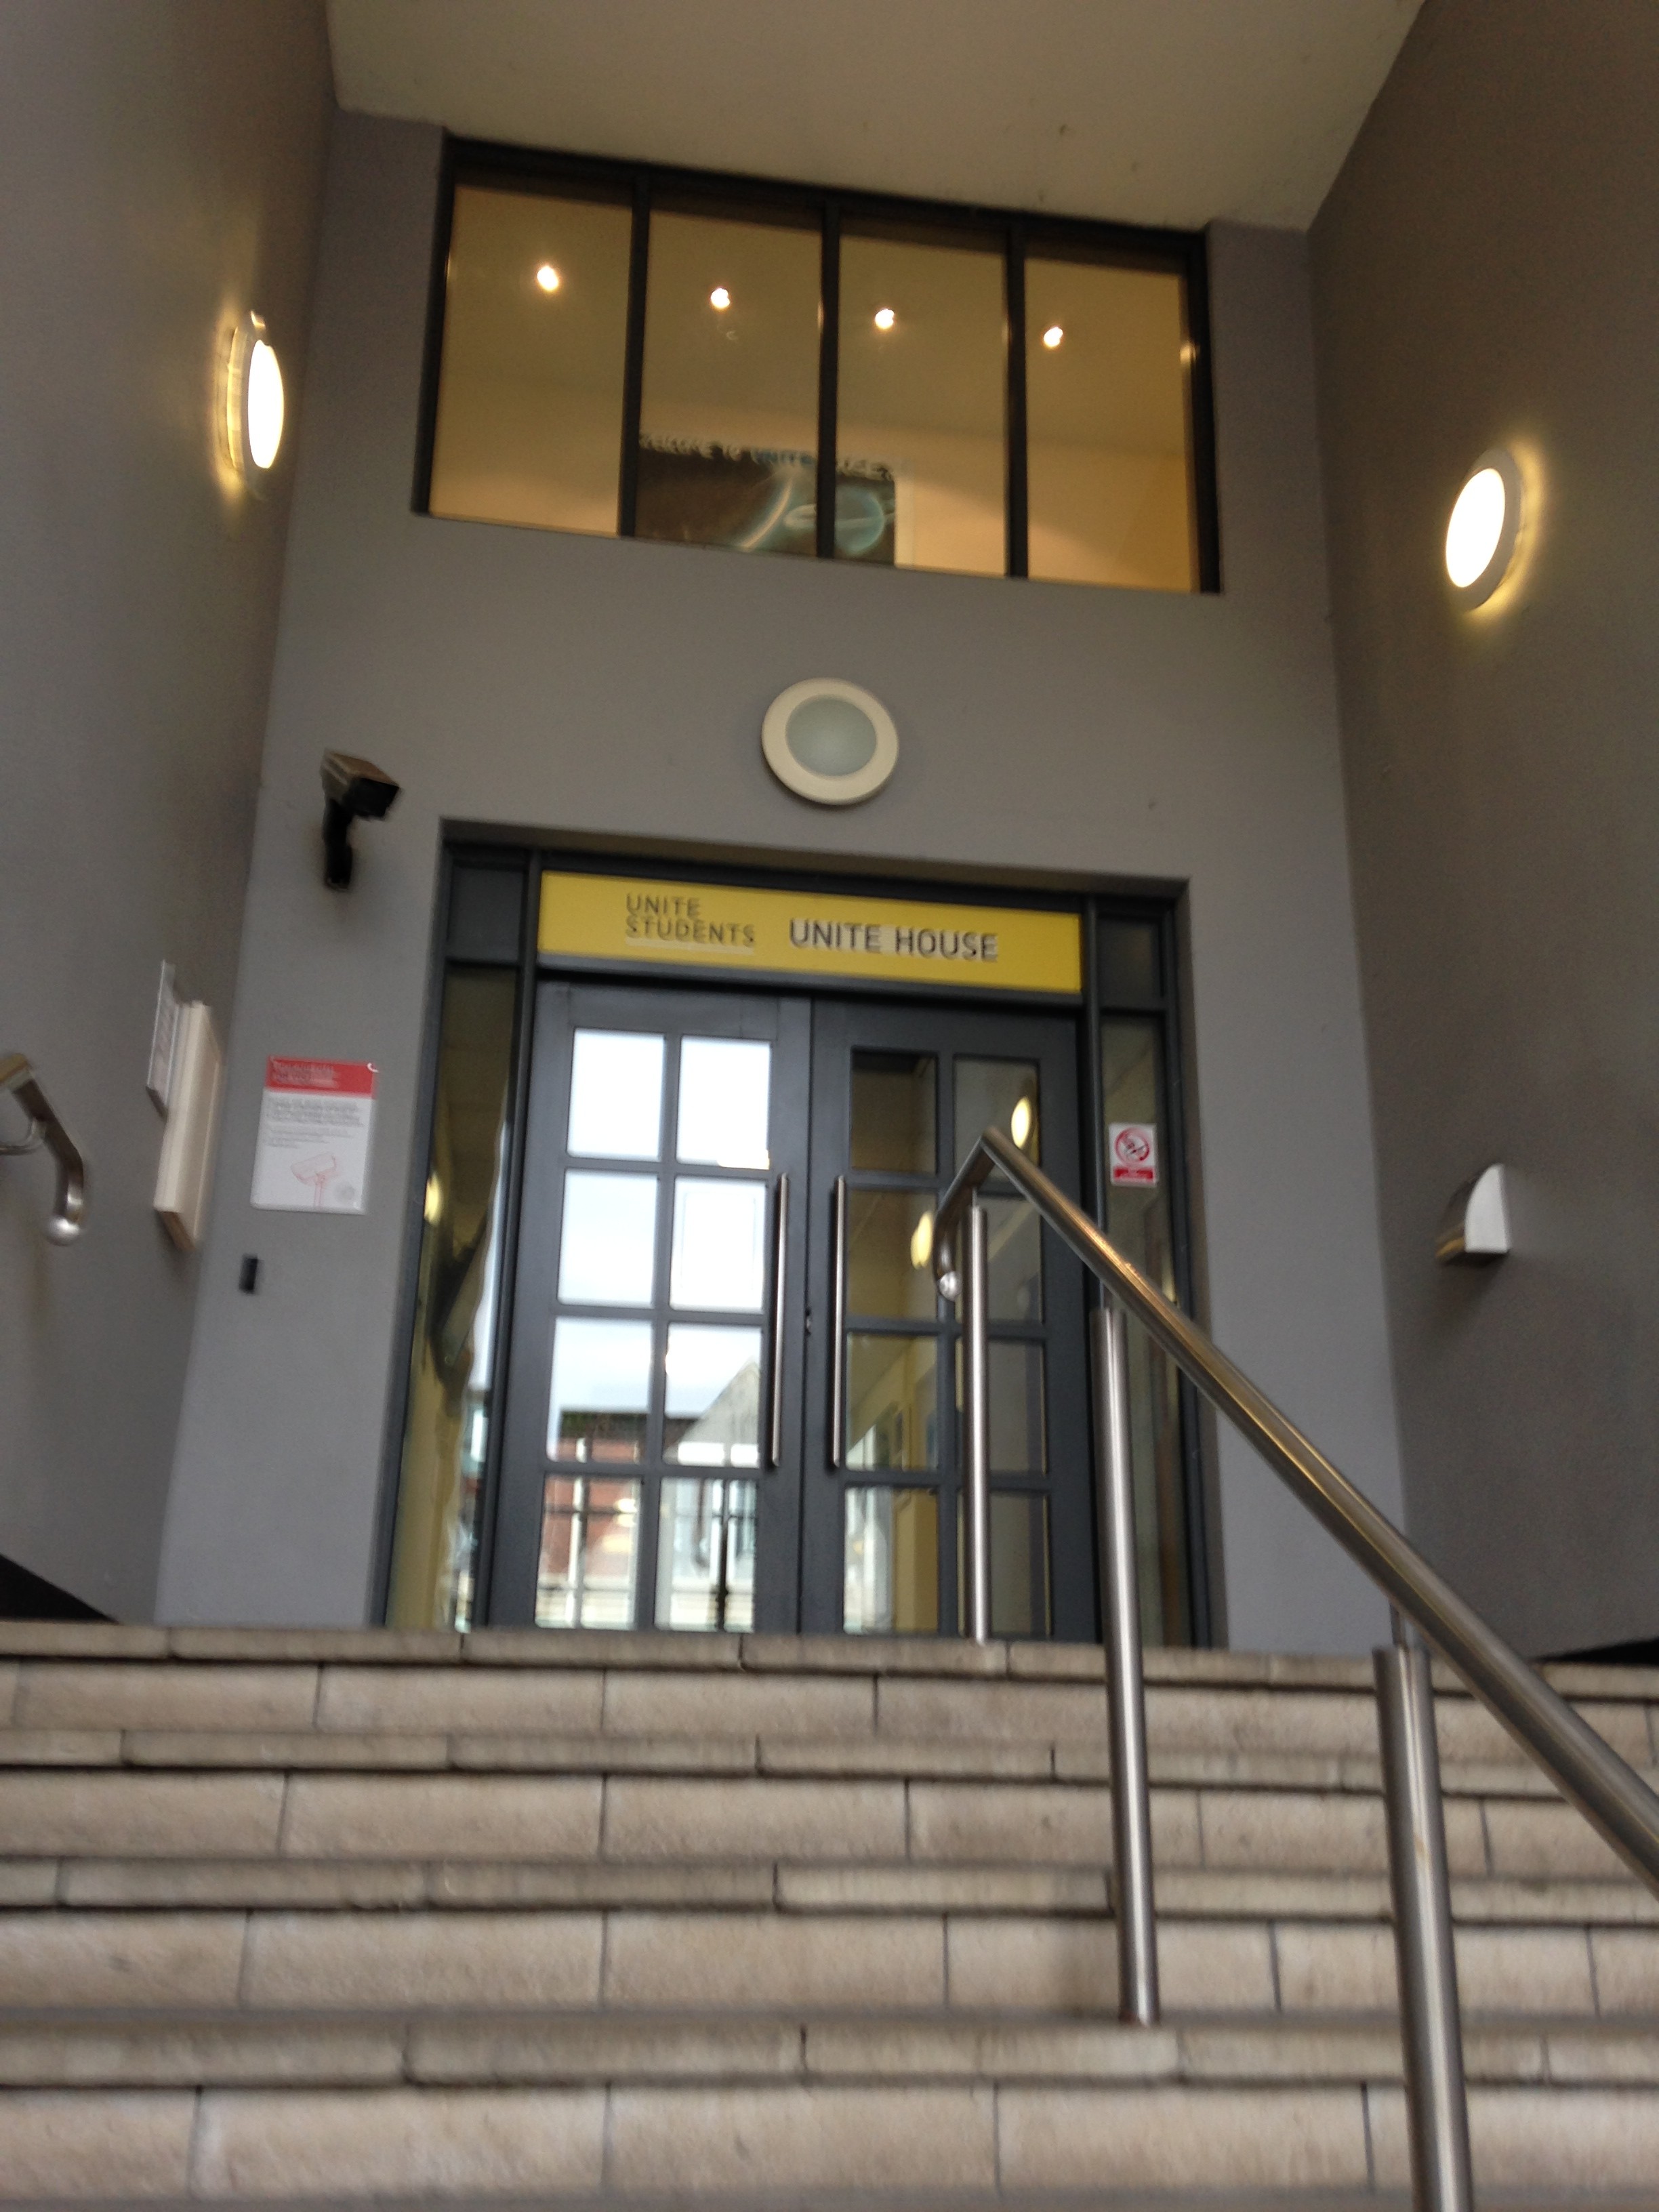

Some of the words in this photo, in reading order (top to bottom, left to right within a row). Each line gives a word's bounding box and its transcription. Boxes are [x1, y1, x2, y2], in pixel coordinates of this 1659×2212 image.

[626, 893, 701, 919] UNITE
[626, 914, 756, 948] STUDENTS
[790, 918, 882, 954] UNITE
[895, 926, 999, 963] HOUSE
